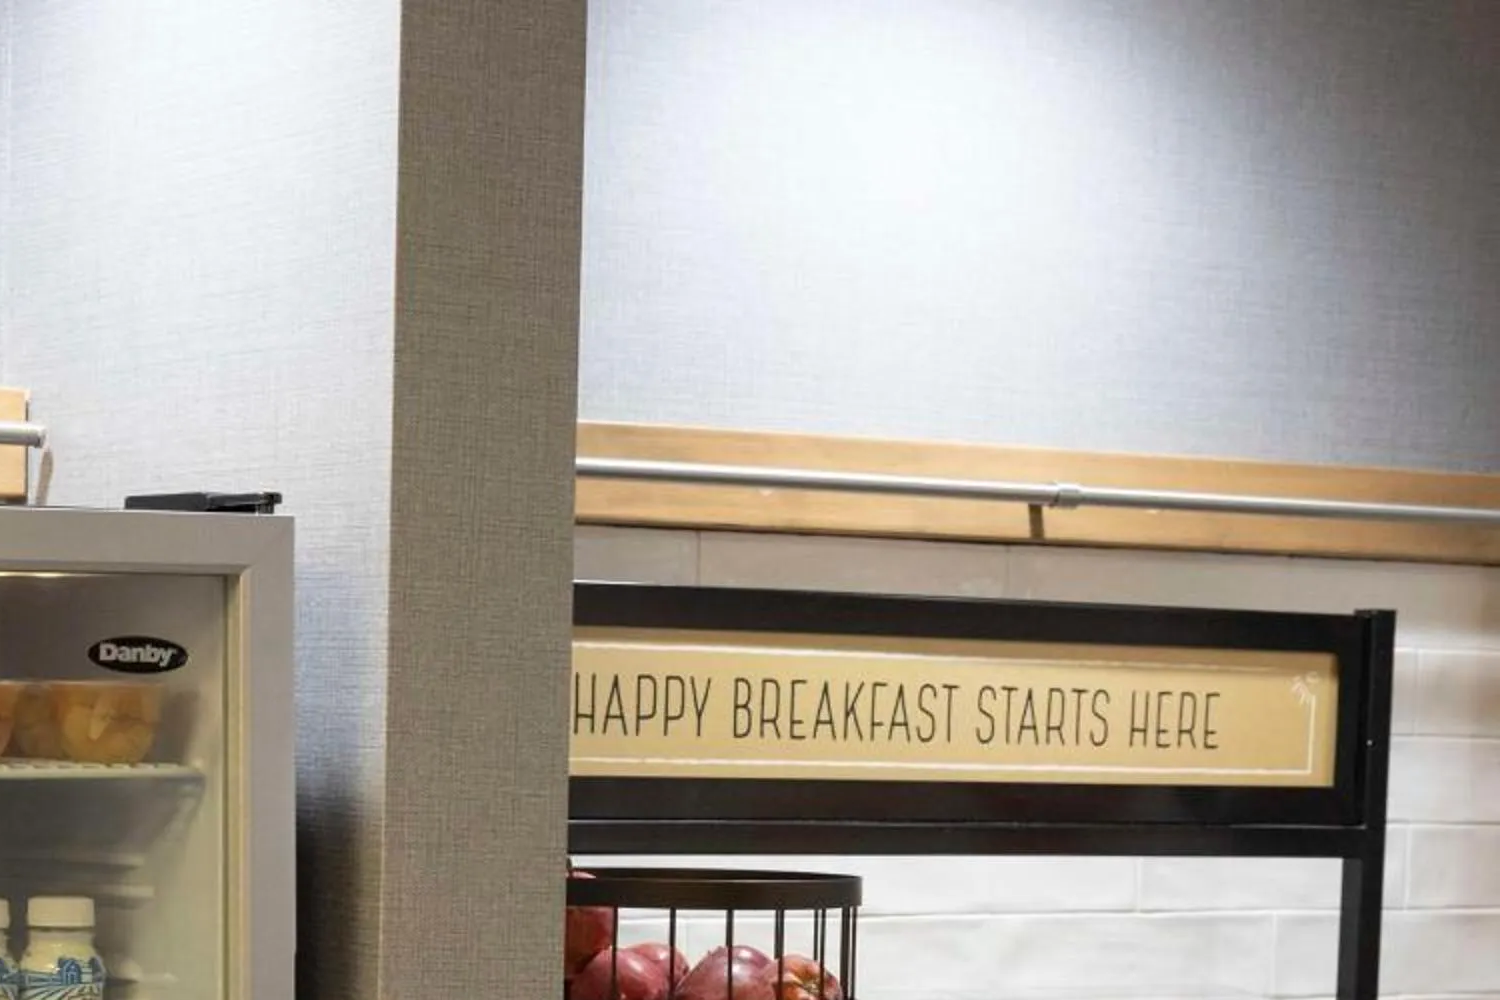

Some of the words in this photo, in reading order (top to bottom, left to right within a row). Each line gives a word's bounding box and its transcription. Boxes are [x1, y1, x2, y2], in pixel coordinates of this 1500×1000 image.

[99, 641, 173, 667] Danby
[573, 671, 712, 738] HAPPY
[732, 677, 961, 743] BREAKFAST
[975, 685, 1111, 747] STARTS
[1128, 690, 1221, 750] HERE
